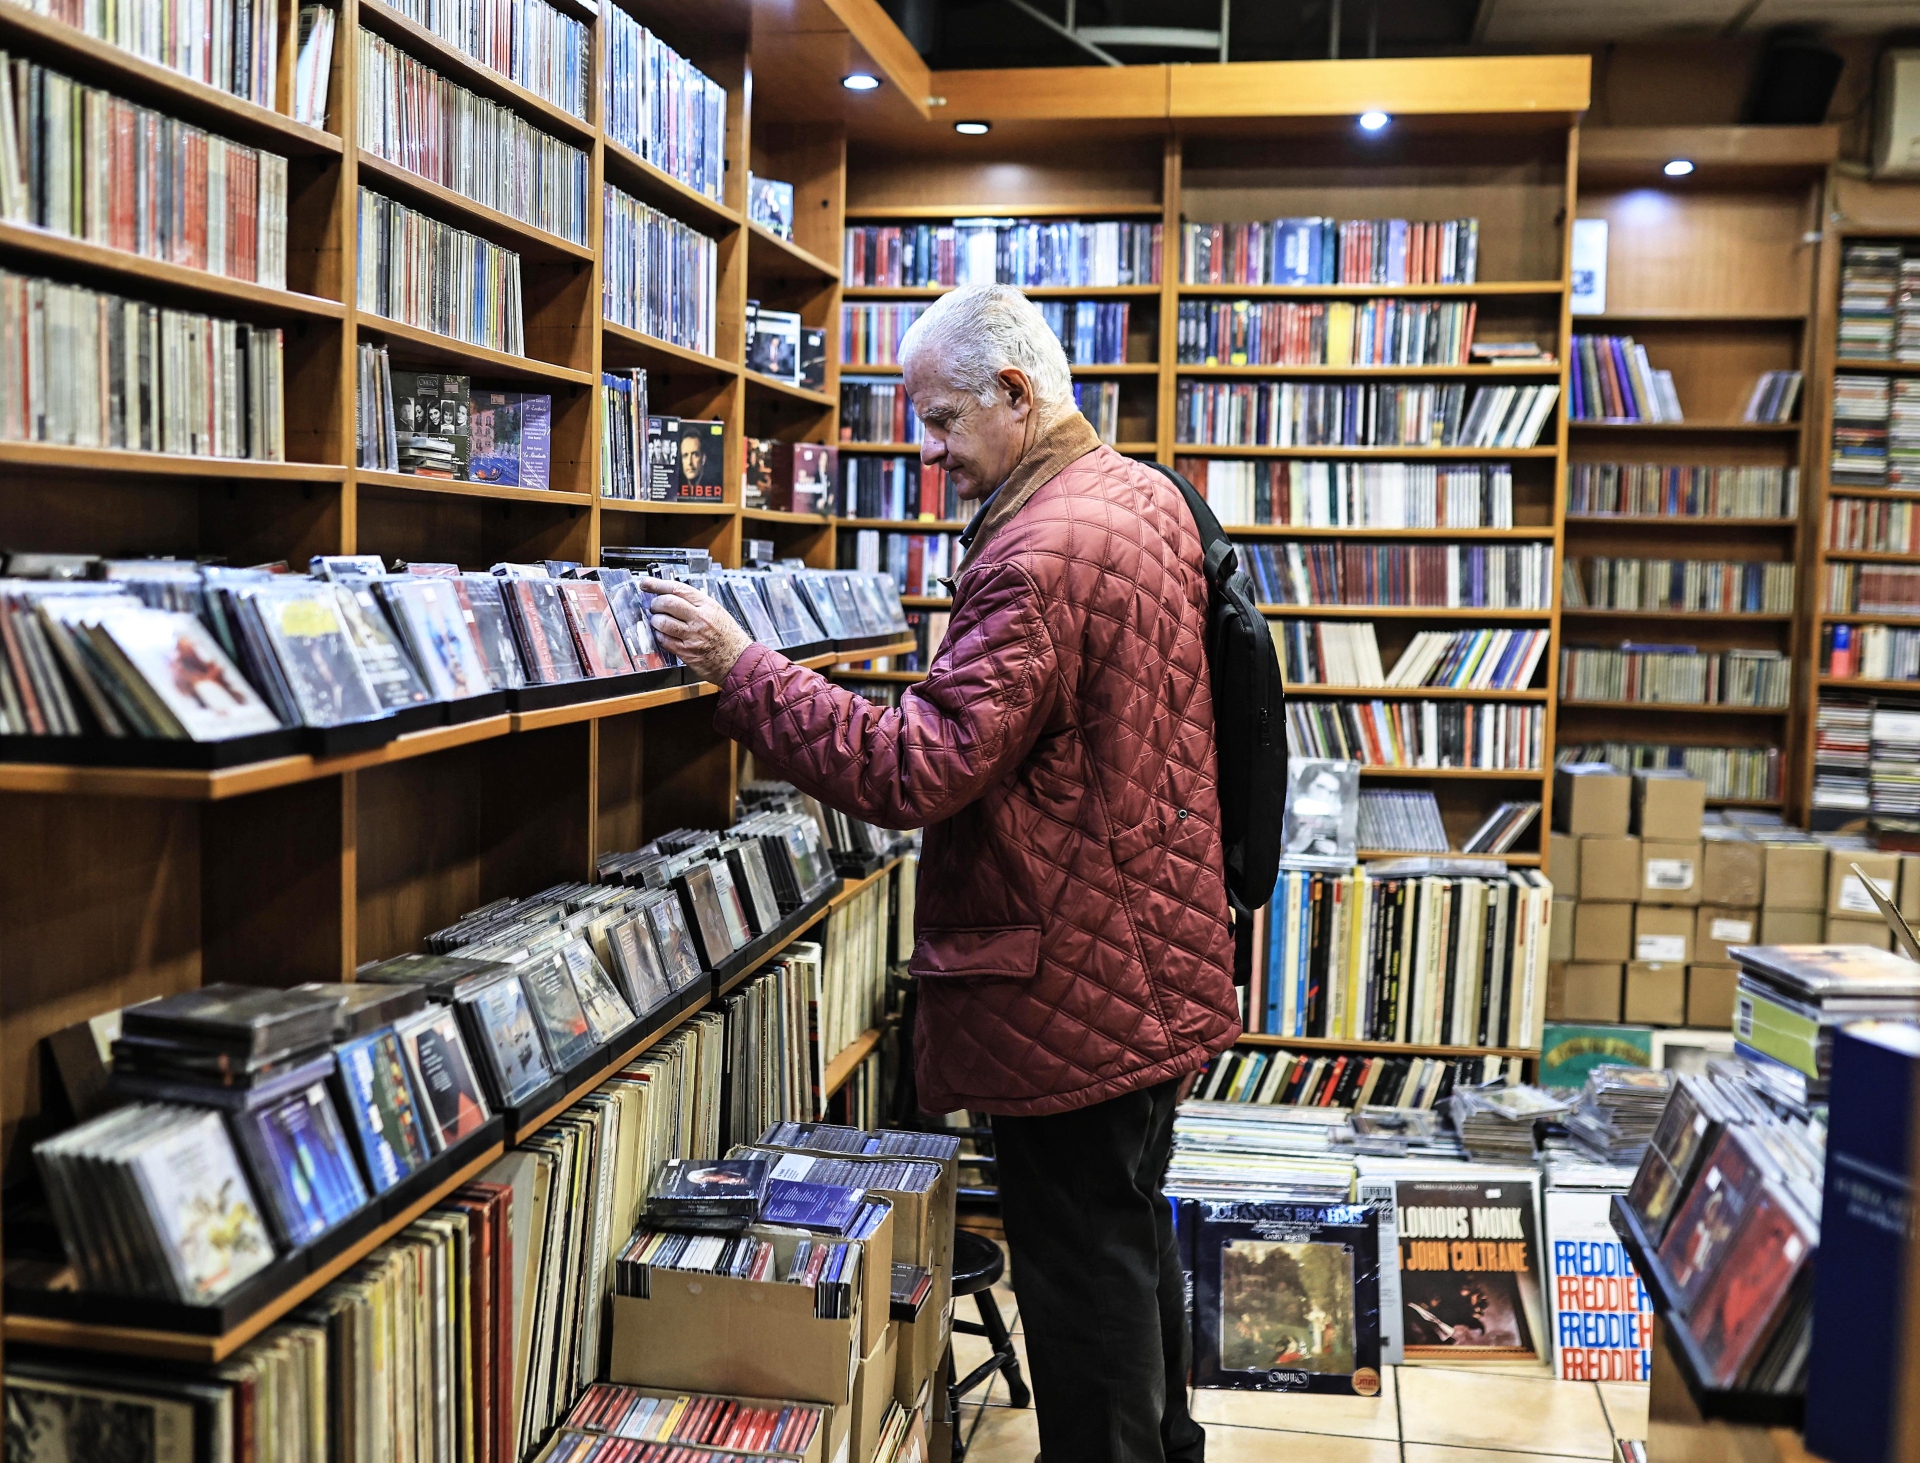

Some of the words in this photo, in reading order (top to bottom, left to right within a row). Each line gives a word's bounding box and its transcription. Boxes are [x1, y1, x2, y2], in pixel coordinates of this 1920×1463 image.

[677, 484, 723, 497] EIBER
[599, 1148, 608, 1203] BRAHMS
[1210, 1204, 1292, 1220] JOHANNES
[1294, 1206, 1364, 1224] BRAHMS
[1471, 1206, 1525, 1239] MONK
[1406, 1240, 1450, 1271] JOHN
[1450, 1241, 1530, 1272] COLTRANE
[1555, 1240, 1640, 1277] FREDDIE
